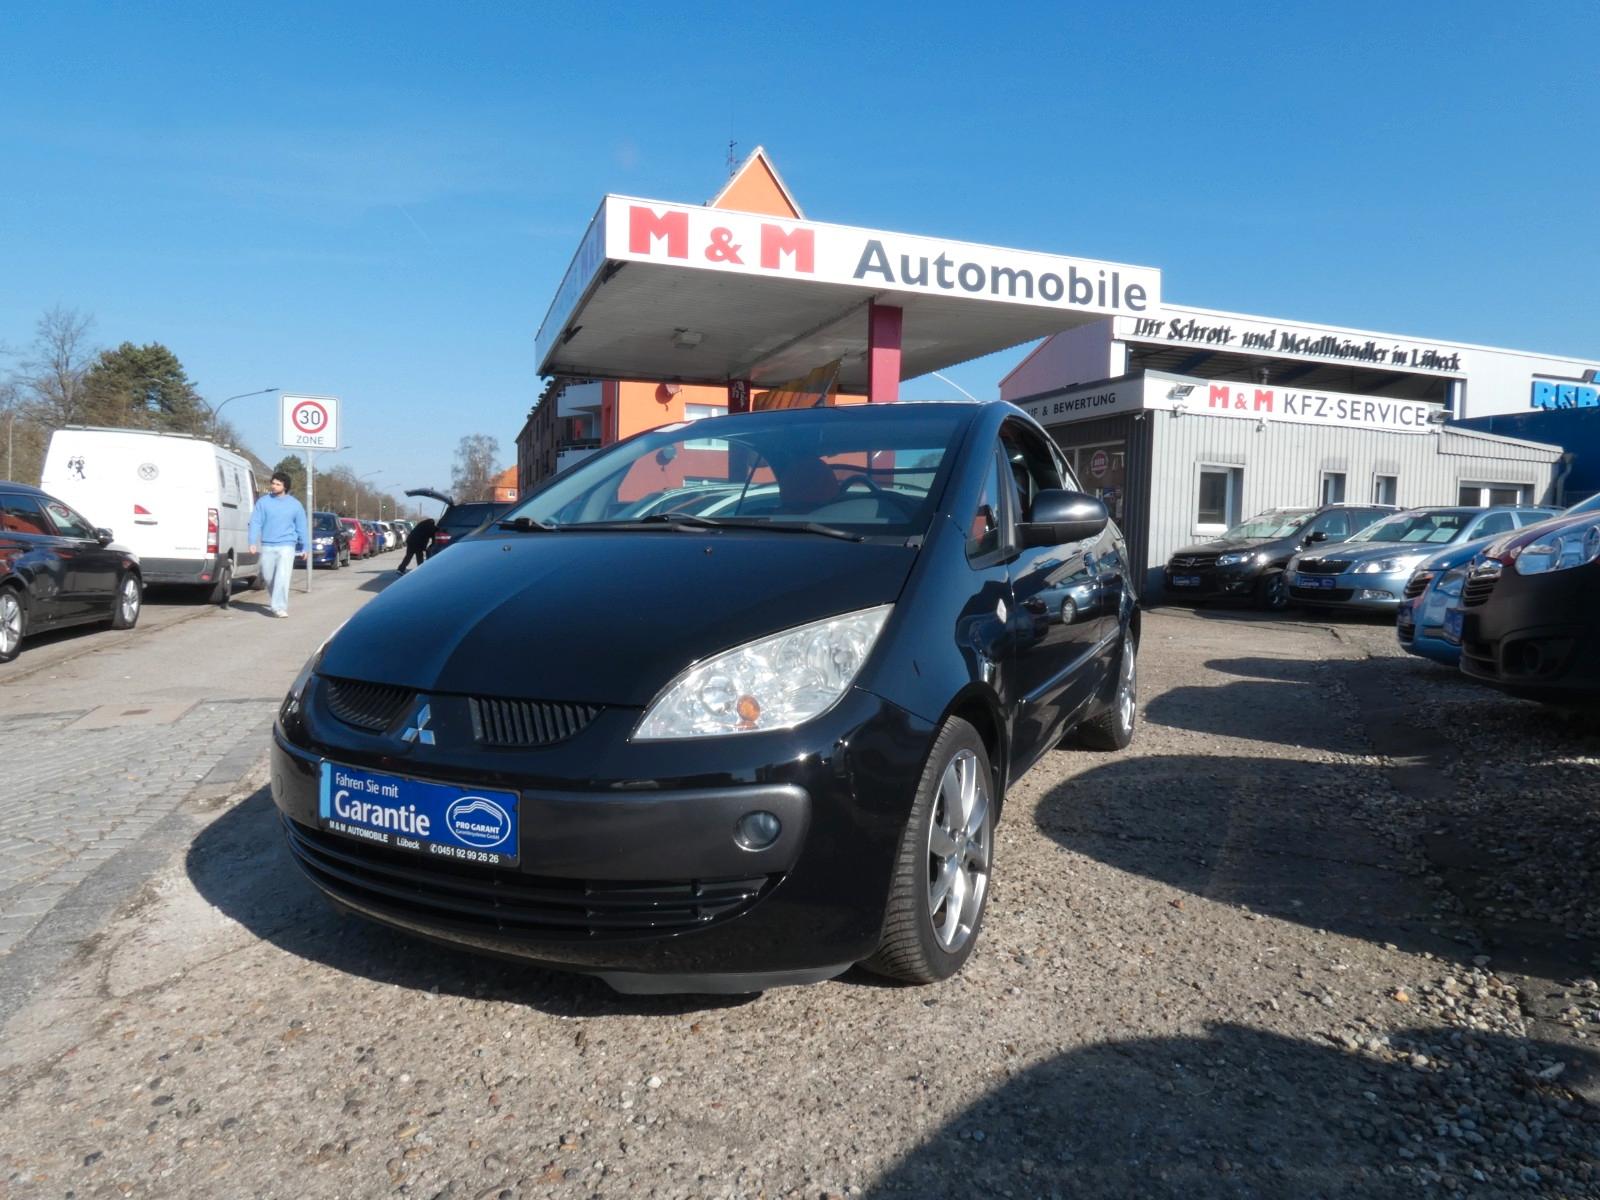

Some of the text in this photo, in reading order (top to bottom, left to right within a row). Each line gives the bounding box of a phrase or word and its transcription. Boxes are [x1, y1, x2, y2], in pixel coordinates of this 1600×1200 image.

[629, 205, 1148, 312] M & M Automobile
[1241, 328, 1277, 349] und
[1391, 344, 1407, 365] in
[1053, 392, 1117, 415] BEWERTUNG
[1208, 384, 1230, 409] M
[1234, 392, 1248, 410] &
[1253, 388, 1274, 413] M
[299, 409, 321, 426] 30
[295, 435, 325, 445] ZONE
[335, 772, 400, 799] Fahren Sie mit
[334, 789, 431, 837] Garantie
[455, 821, 471, 830] PRO
[471, 823, 501, 834] GARANT
[347, 825, 389, 843] AUTOMOBILE
[396, 836, 420, 850] Lübeck
[456, 848, 466, 858] 92
[466, 851, 477, 861] 99
[477, 853, 488, 862] 26
[488, 854, 500, 864] 26
